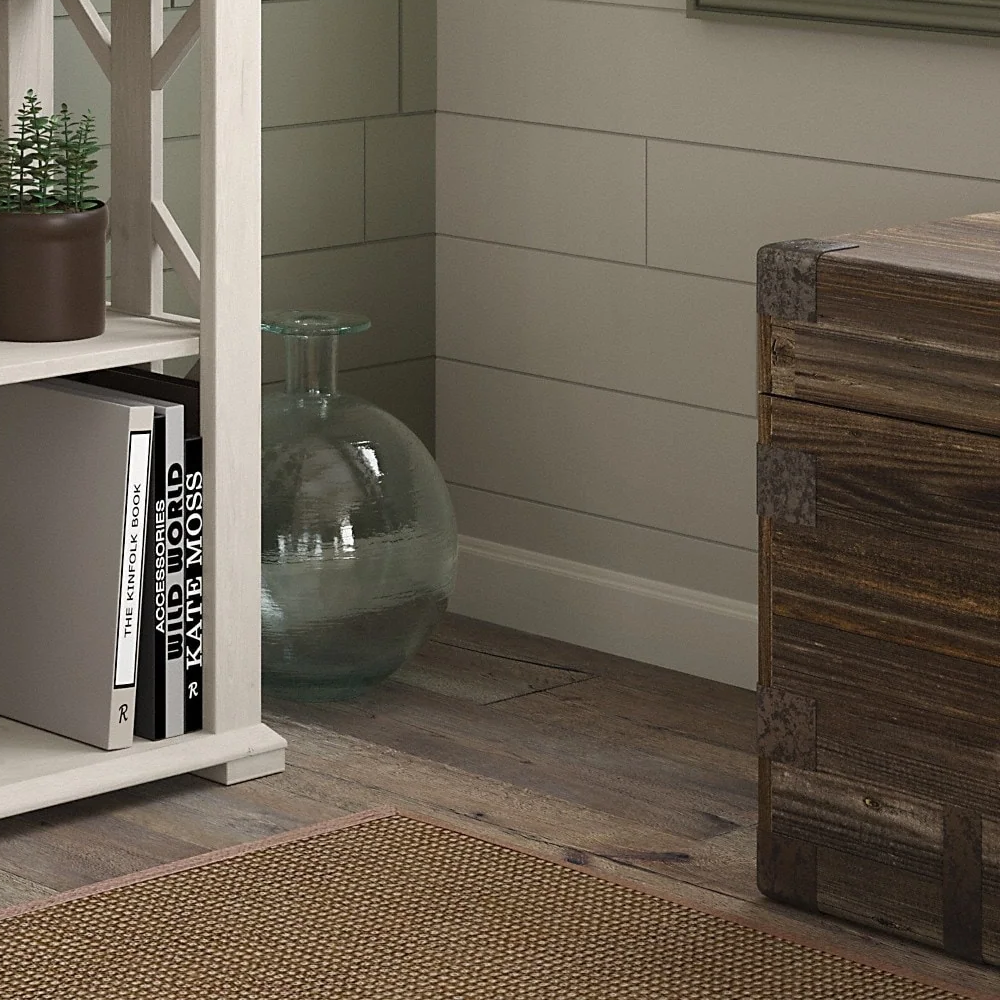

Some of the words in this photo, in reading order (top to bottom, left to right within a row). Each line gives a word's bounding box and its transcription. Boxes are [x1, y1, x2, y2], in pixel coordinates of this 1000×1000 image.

[131, 484, 141, 527] BOOK
[167, 463, 183, 573] WORLD
[185, 471, 202, 568] MOSS
[126, 534, 138, 601] KINFOLK
[155, 500, 165, 633] ACCESSORIES
[124, 607, 133, 638] THE
[167, 584, 183, 660] WILD
[186, 577, 202, 670] KATE
